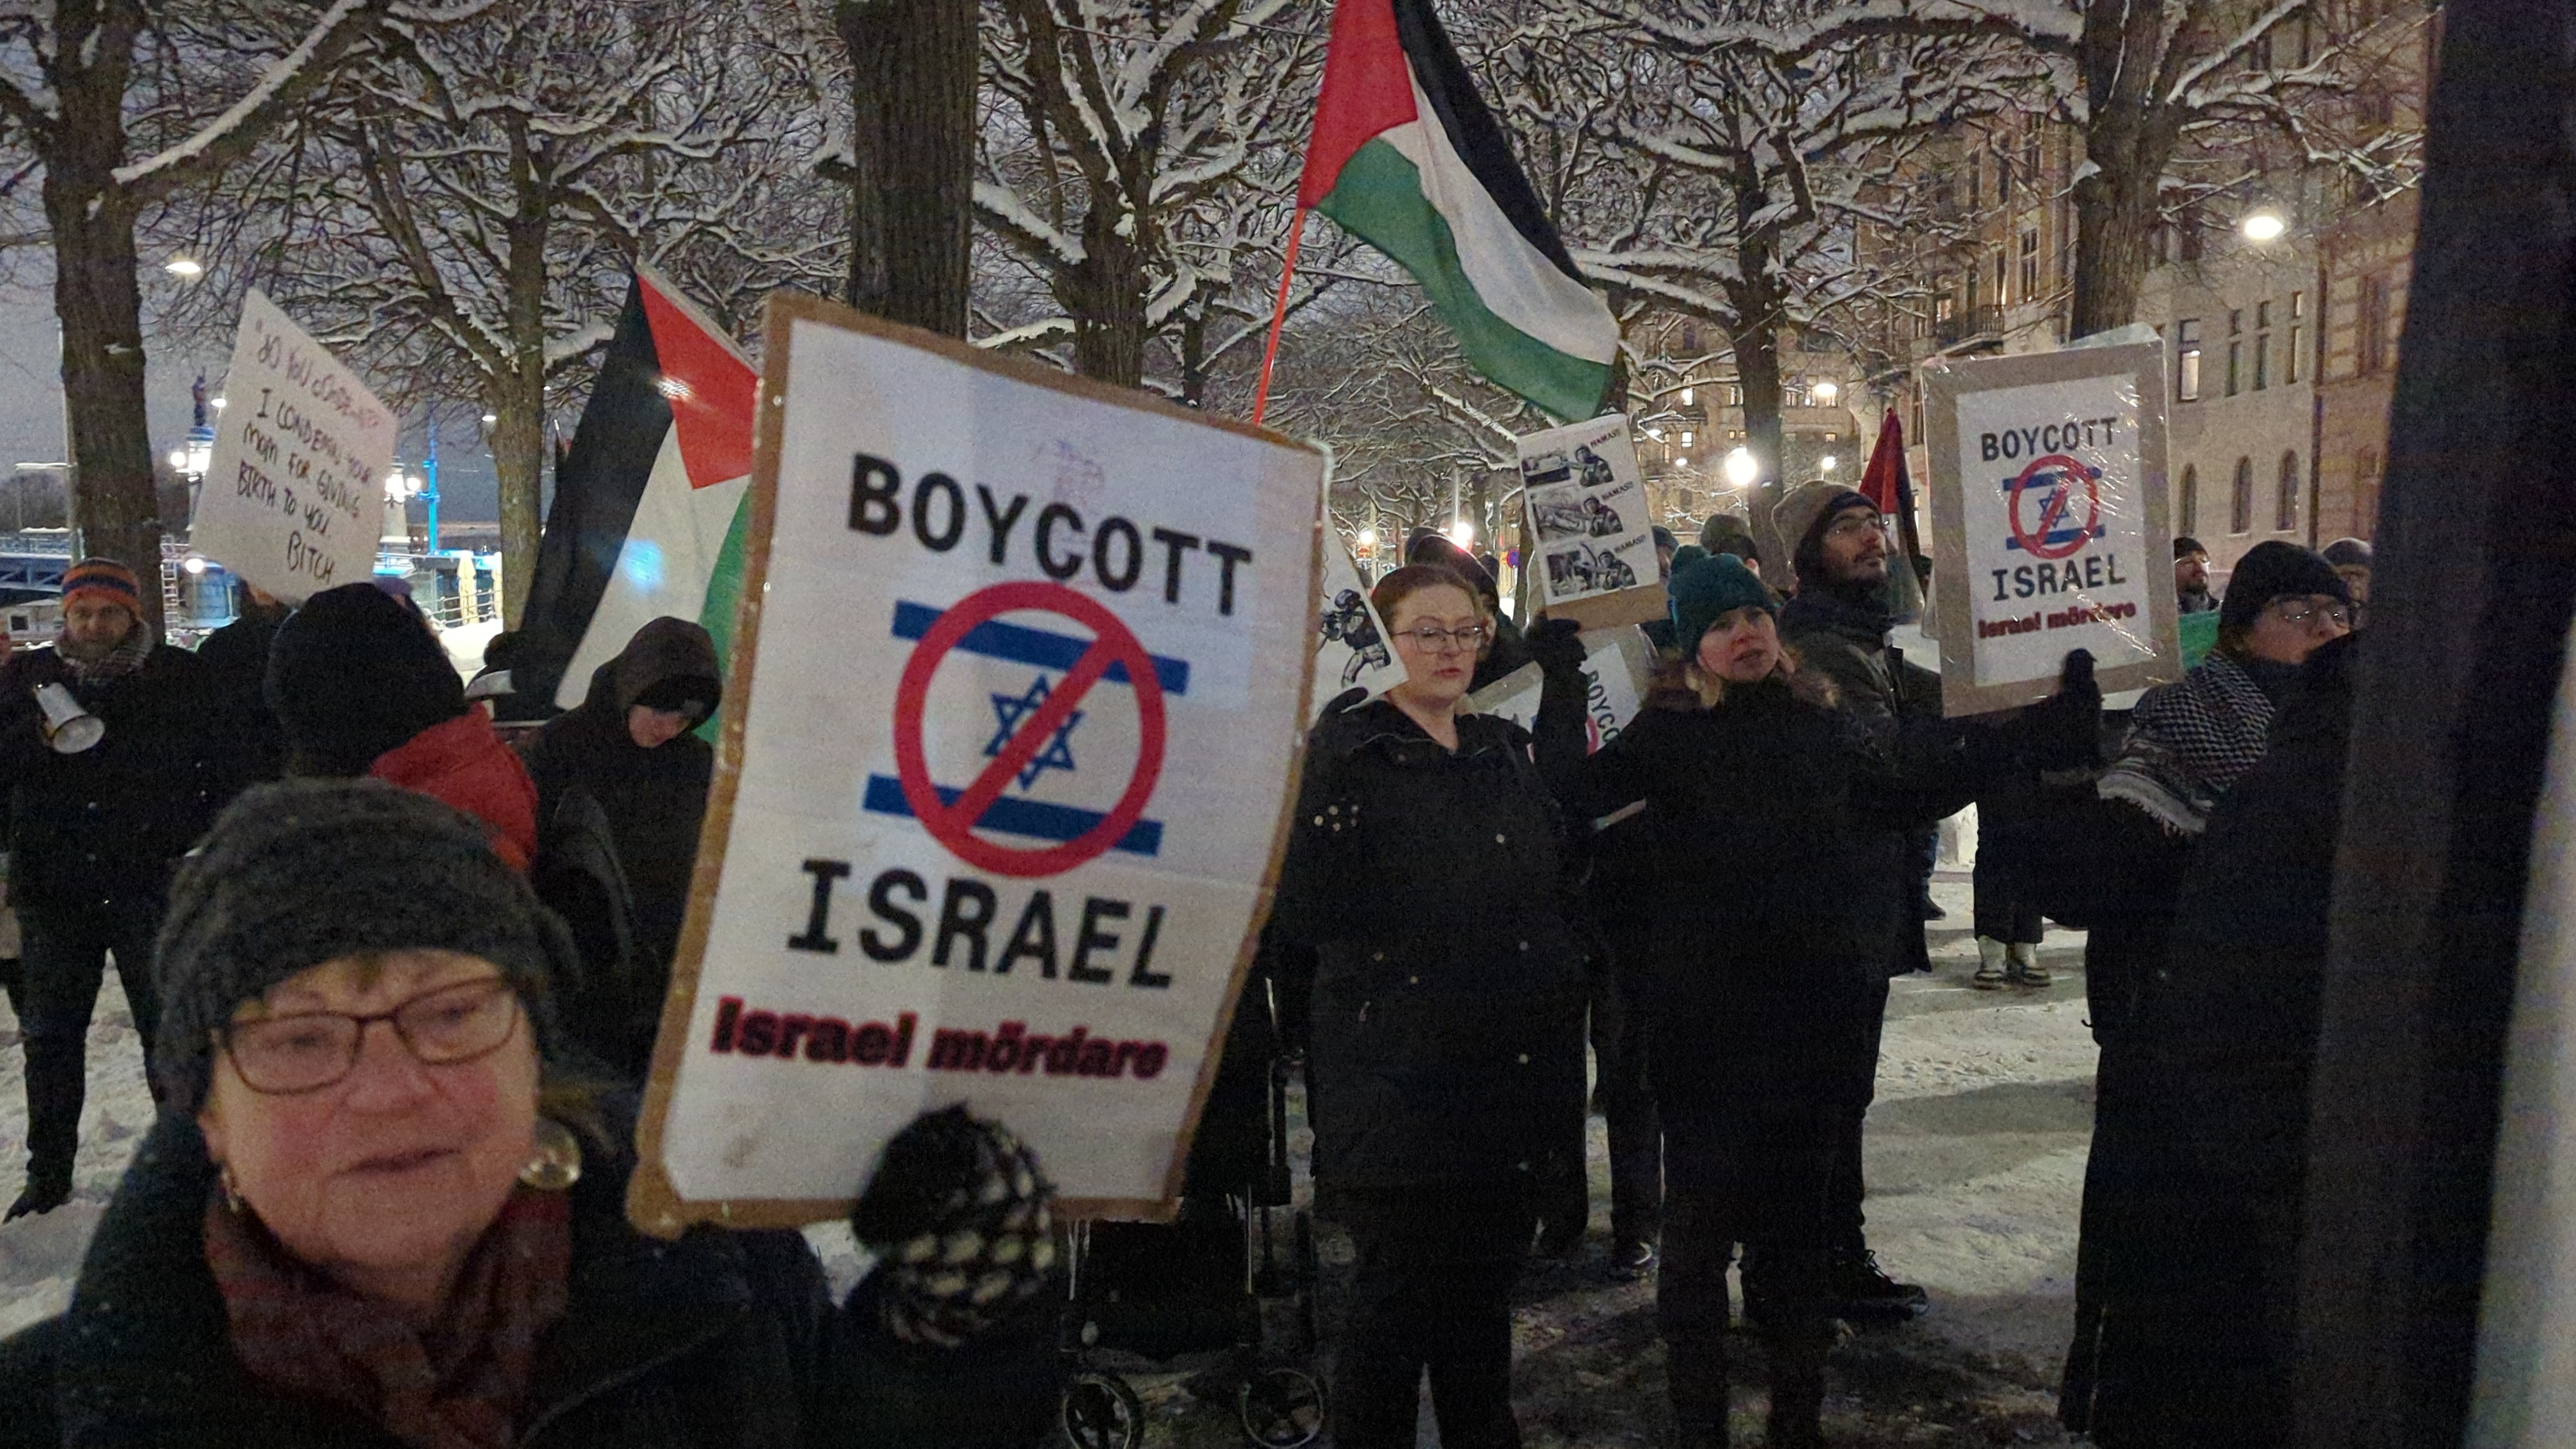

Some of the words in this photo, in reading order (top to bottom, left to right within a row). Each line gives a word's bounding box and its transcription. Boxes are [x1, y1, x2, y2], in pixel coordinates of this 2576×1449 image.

[257, 388, 272, 418] I
[243, 420, 278, 466] MOM
[1981, 417, 2117, 462] BOYCOTT
[237, 458, 277, 508] BIRTH
[284, 487, 296, 516] TO
[287, 530, 335, 585] BITCH
[848, 452, 1254, 617] BOYCOTT
[1991, 553, 2126, 601] ISRAEL
[1978, 611, 2042, 640] Israel
[786, 858, 1174, 990] ISRAEL
[710, 995, 918, 1069] Israel
[925, 1021, 1170, 1080] mördare
